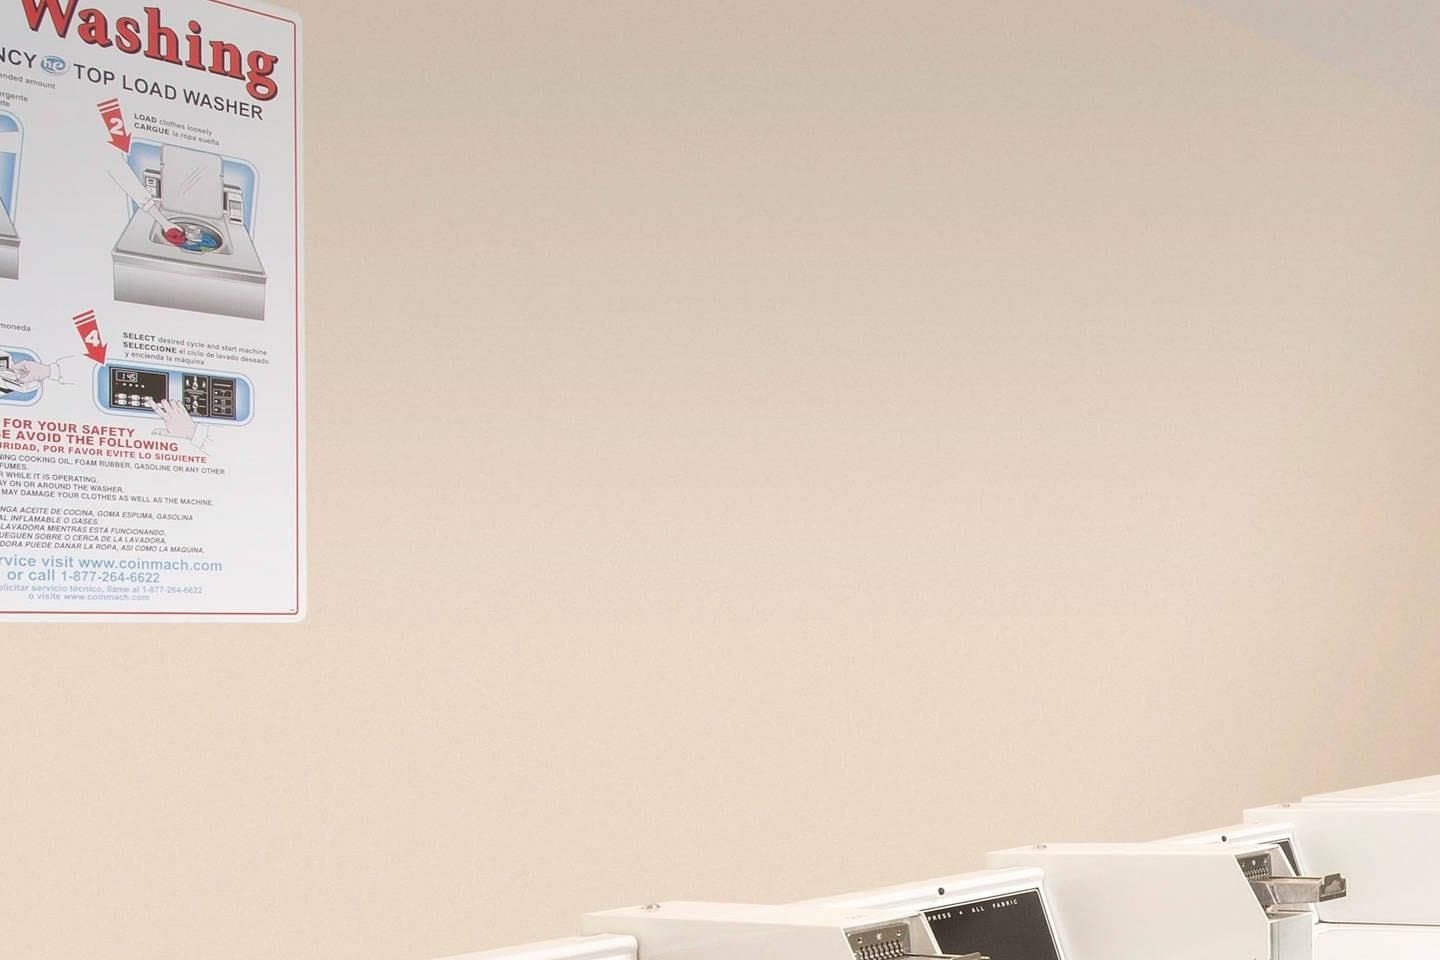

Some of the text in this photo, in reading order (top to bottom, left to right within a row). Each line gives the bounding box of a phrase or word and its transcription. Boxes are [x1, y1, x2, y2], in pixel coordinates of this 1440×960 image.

[21, 0, 279, 102] Washing
[25, 78, 56, 89] amount
[74, 64, 115, 85] TOP
[123, 75, 177, 101] LOAD
[184, 89, 263, 120] WASHER
[110, 117, 124, 136] 2
[134, 113, 213, 137] LOAD clothes loosely
[134, 122, 170, 136] CARGUE
[85, 330, 101, 347] 4
[123, 332, 156, 342] SELECT
[158, 337, 184, 346] desired
[186, 340, 205, 350] cycle
[207, 342, 219, 351] and
[238, 346, 267, 356] machine
[123, 341, 177, 354] SELECCIONE
[179, 347, 186, 355] el
[205, 351, 215, 359] de
[216, 353, 239, 361] lavado
[131, 352, 164, 361] encienda
[3, 418, 135, 438] FOR YOUR SAFETY
[16, 431, 61, 443] AVOID
[66, 434, 94, 446] THE
[99, 437, 178, 452] FOLLOWING
[43, 445, 65, 454] POR
[69, 447, 103, 457] FAVOR
[107, 450, 136, 459] EVITE
[155, 453, 207, 464] SIGUIENTE
[19, 455, 56, 464] COOKING
[75, 458, 97, 466] FOAM
[134, 462, 172, 472] GASOLINE
[201, 467, 225, 475] OTHER
[6, 471, 31, 480] WHILE
[37, 482, 74, 491] AROUND
[1, 488, 19, 496] MAY
[20, 489, 55, 498] DAMAGE
[57, 491, 79, 499] YOUR
[81, 492, 117, 502] CLOTHES
[165, 497, 178, 505] THE
[10, 515, 62, 524] INFLAMABLE
[20, 506, 49, 515] ACEITE
[97, 510, 120, 518] GOMA
[156, 513, 193, 521] GASOLINA
[47, 525, 87, 533] MIENTRAS
[35, 532, 63, 541] SOBRE
[72, 534, 99, 542] CERCA
[101, 535, 112, 543] DE
[25, 541, 53, 549] PUEDE
[135, 544, 157, 553] COMO
[41, 555, 74, 568] visit
[79, 558, 222, 571] www.coinmach.com
[7, 568, 160, 583] or call 1-877-264-6622
[31, 584, 67, 592] servicio
[928, 898, 1018, 922] PRESS ALL FABRIC
